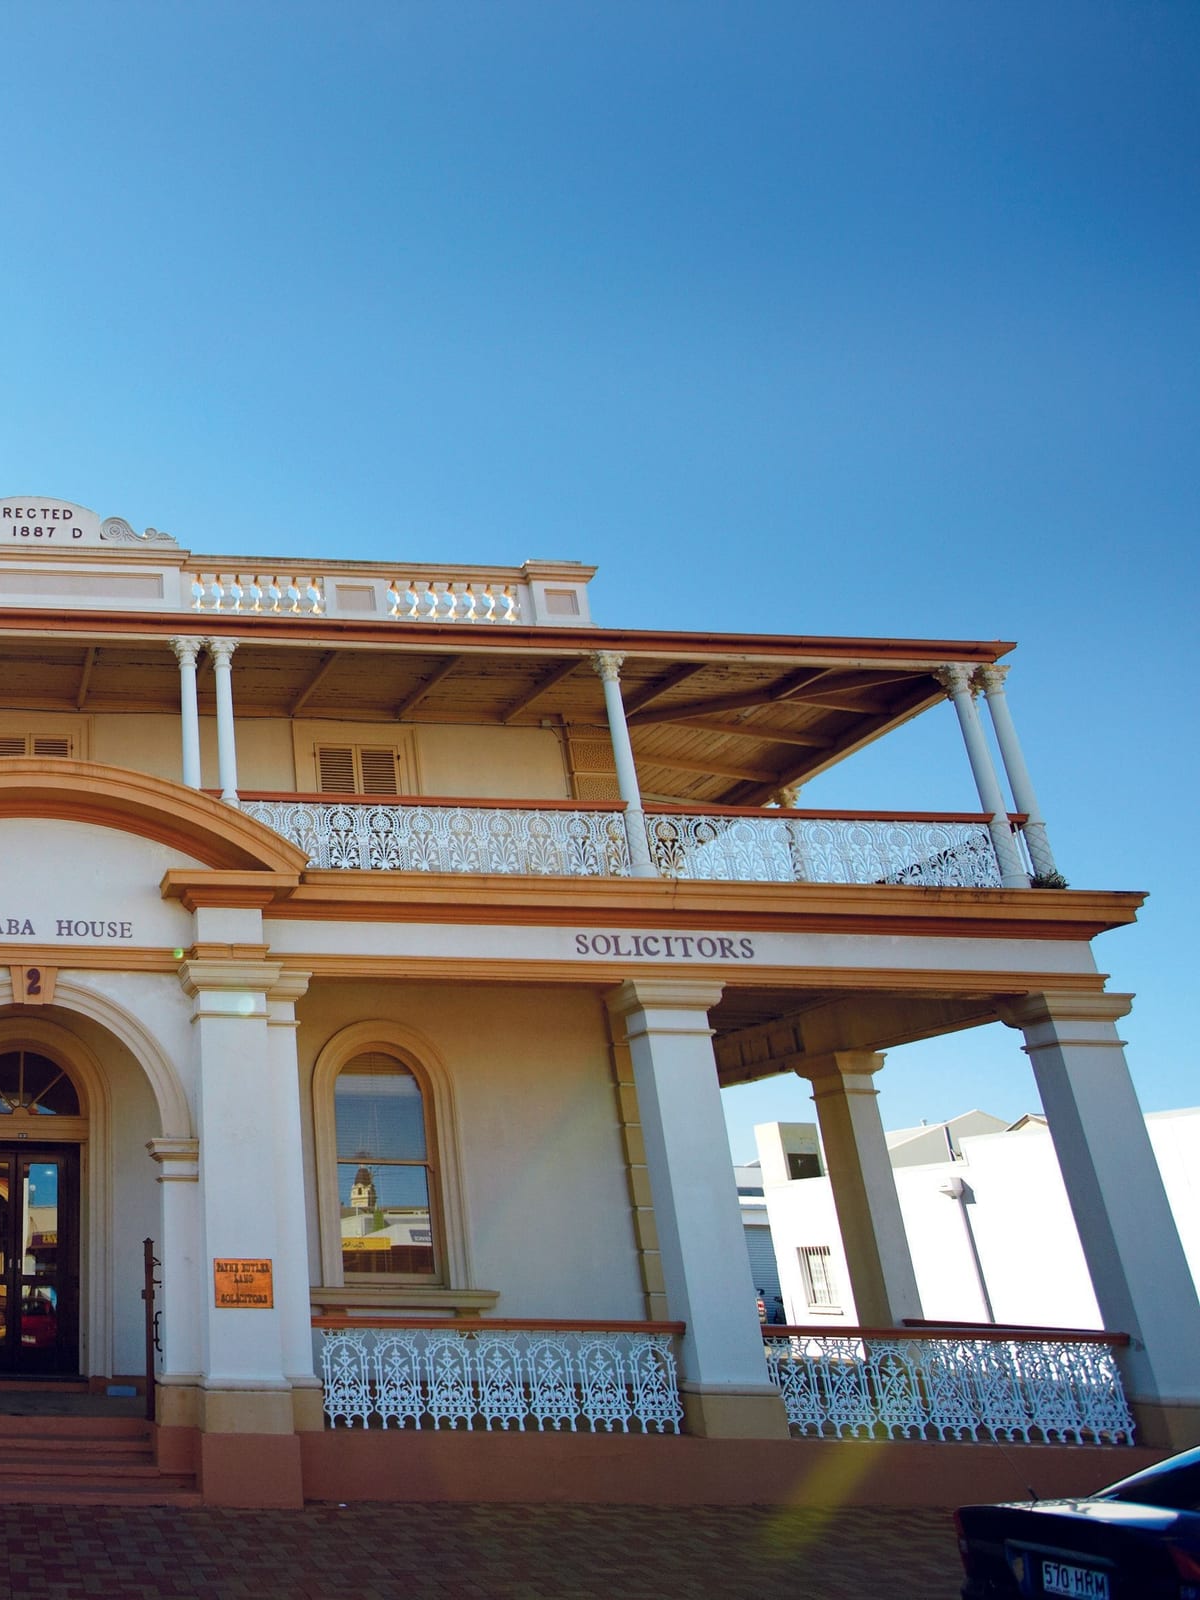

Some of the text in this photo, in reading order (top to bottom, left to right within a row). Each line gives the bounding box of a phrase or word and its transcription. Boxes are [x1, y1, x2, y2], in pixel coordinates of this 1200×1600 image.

[13, 526, 56, 537] 1887
[72, 527, 83, 538] D
[55, 919, 134, 939] HOUSE
[575, 934, 755, 959] SOLICITORS
[26, 968, 42, 995] 2
[216, 1262, 270, 1273] PAYNE BUTLER
[233, 1274, 254, 1284] LANG
[220, 1293, 268, 1304] SOLICITORS
